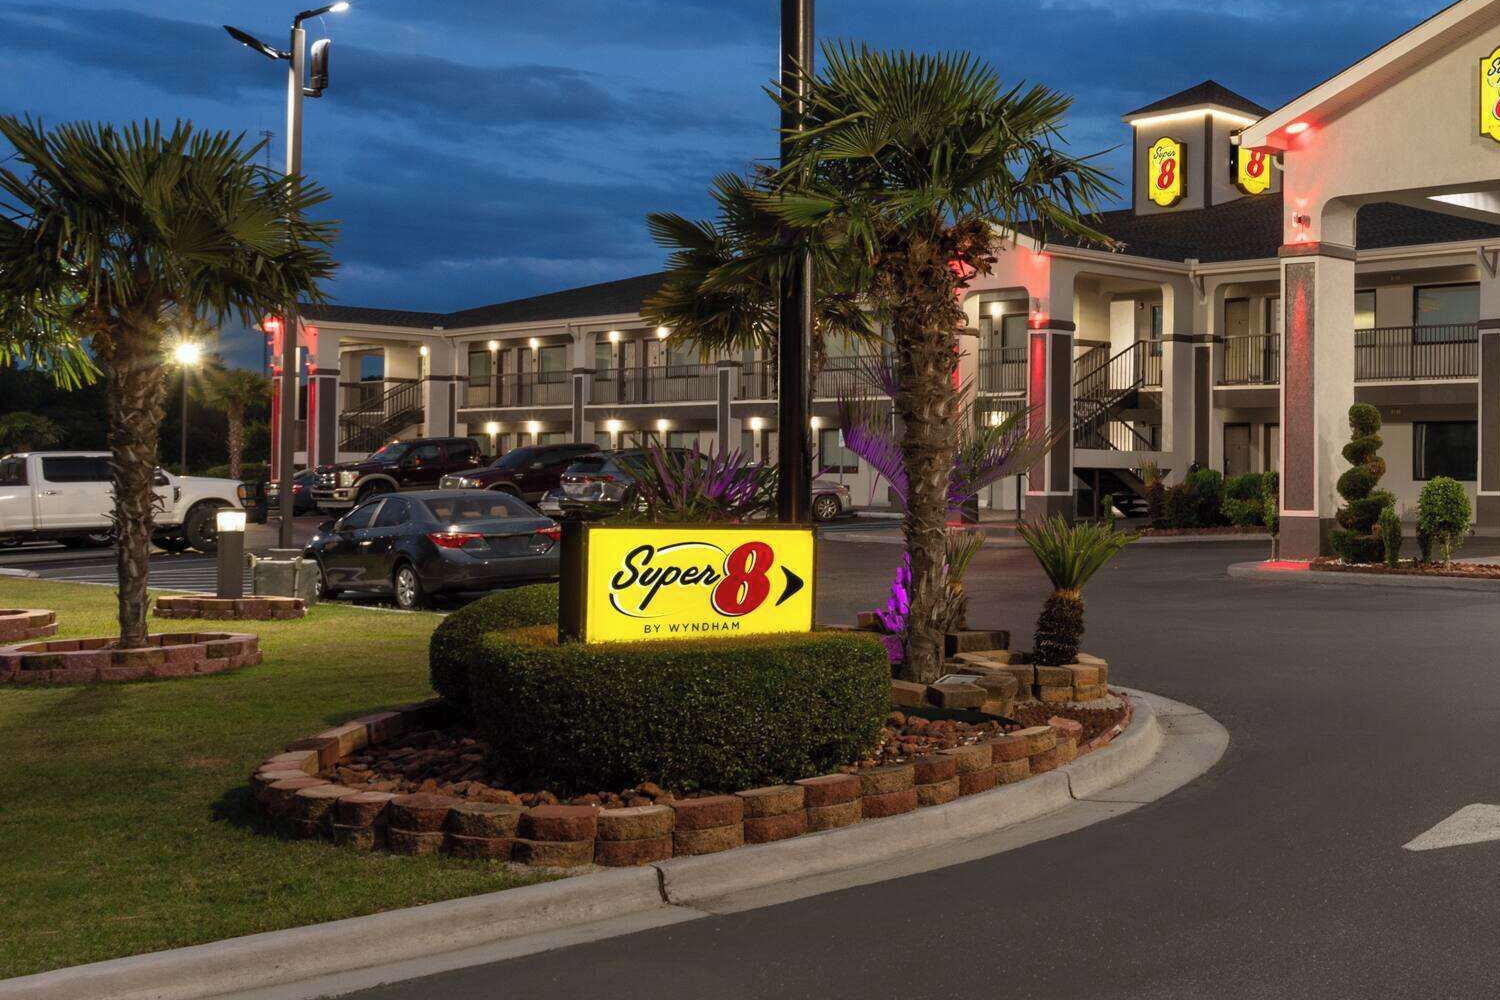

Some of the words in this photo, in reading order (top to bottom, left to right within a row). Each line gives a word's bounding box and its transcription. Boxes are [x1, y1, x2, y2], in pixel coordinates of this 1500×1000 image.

[1157, 158, 1176, 190] 8
[610, 544, 721, 611] Super
[711, 541, 774, 617] 8
[644, 624, 660, 633] BY
[669, 621, 740, 632] WYNDHAM
